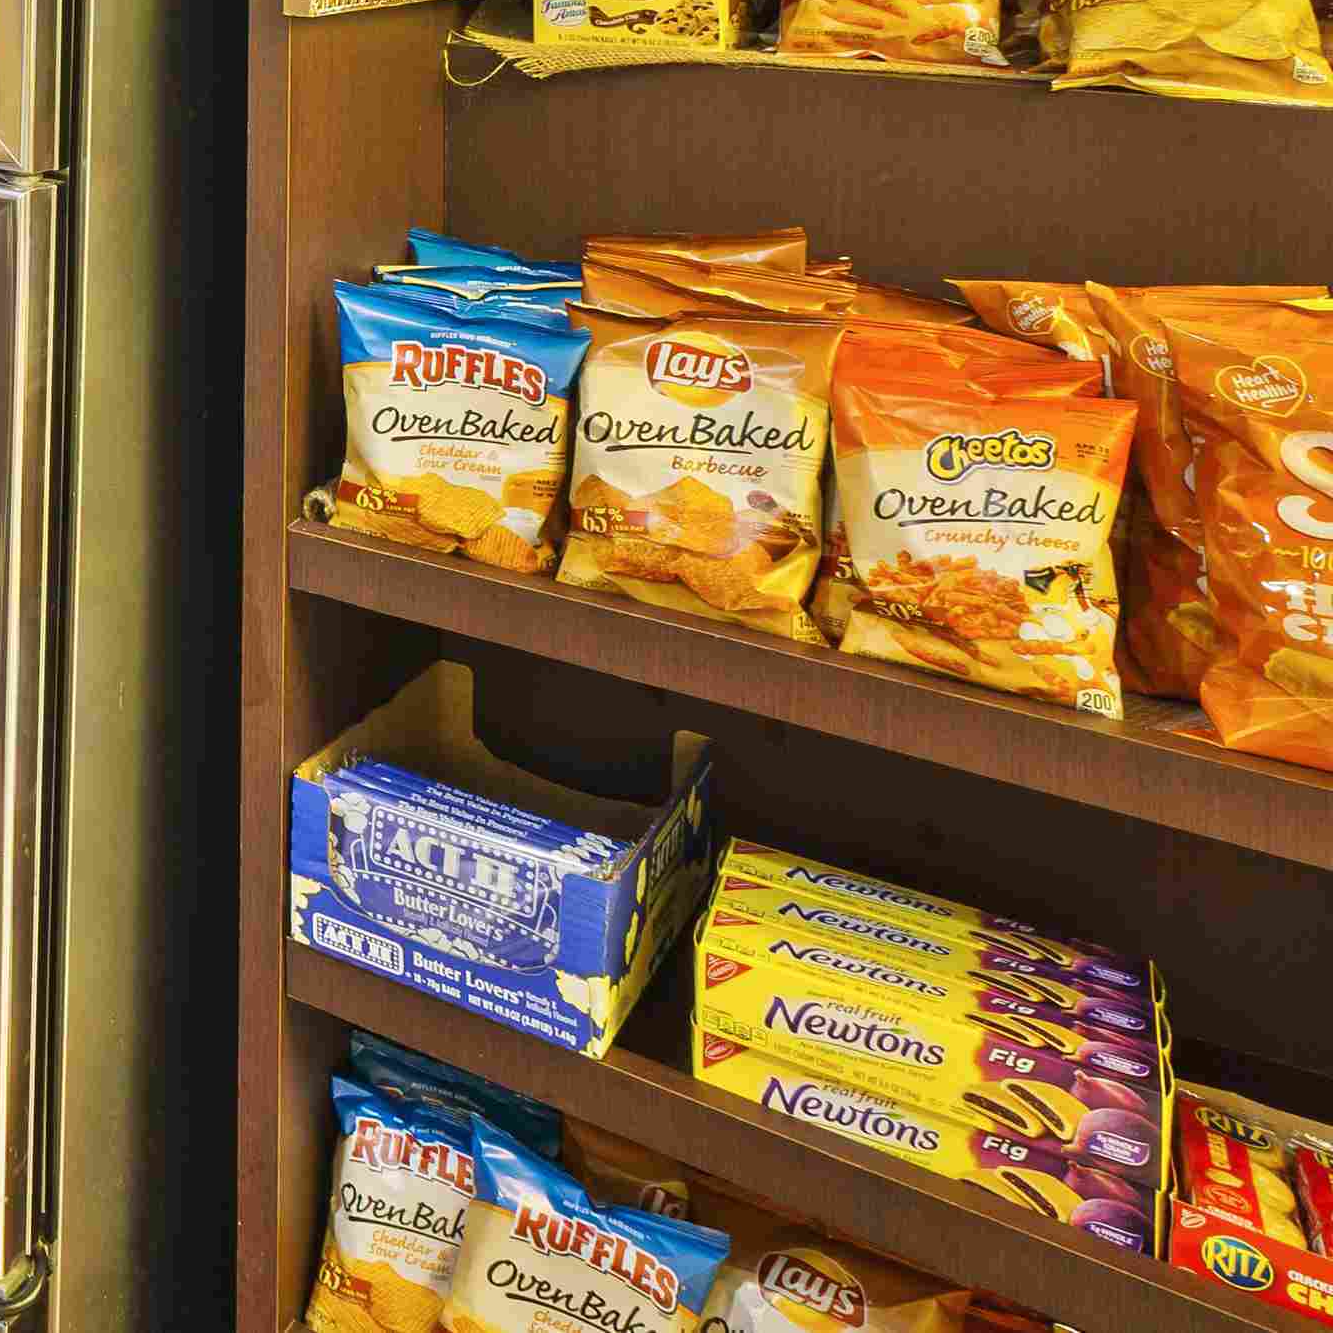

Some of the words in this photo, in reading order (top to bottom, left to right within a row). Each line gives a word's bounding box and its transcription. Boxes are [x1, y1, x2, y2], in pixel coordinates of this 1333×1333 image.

[389, 340, 549, 408] RUFFLES
[372, 406, 459, 436] Oven
[459, 409, 561, 445] Baked
[582, 410, 689, 444] Oven
[689, 410, 816, 452] Baked
[669, 454, 770, 479] Barbecue
[926, 428, 1058, 483] Cheetos
[581, 506, 625, 535] 65%
[874, 487, 983, 520] Oven
[983, 485, 1107, 526] Baked
[1082, 692, 1114, 713] 200
[385, 827, 467, 879] ACT
[393, 886, 450, 920] Butter
[448, 906, 504, 942] Lovers
[785, 865, 954, 918] Newtons
[778, 901, 952, 957] Newtons
[412, 950, 462, 983] Butter
[465, 969, 521, 1005] Lovers
[769, 938, 950, 999] Newtons
[764, 995, 947, 1066] Newtons
[990, 996, 1036, 1016] Fig
[987, 1048, 1036, 1075] Fig
[760, 1076, 942, 1152] Newtons
[349, 1116, 478, 1198] RUFFLE
[982, 1135, 1030, 1163] Fig
[340, 1181, 412, 1226] Oven
[413, 1202, 465, 1241] Bak
[511, 1195, 679, 1315] RUFFLES
[1205, 1236, 1272, 1284] RITZ
[486, 1259, 580, 1312] Oven
[581, 1290, 647, 1333] Bak
